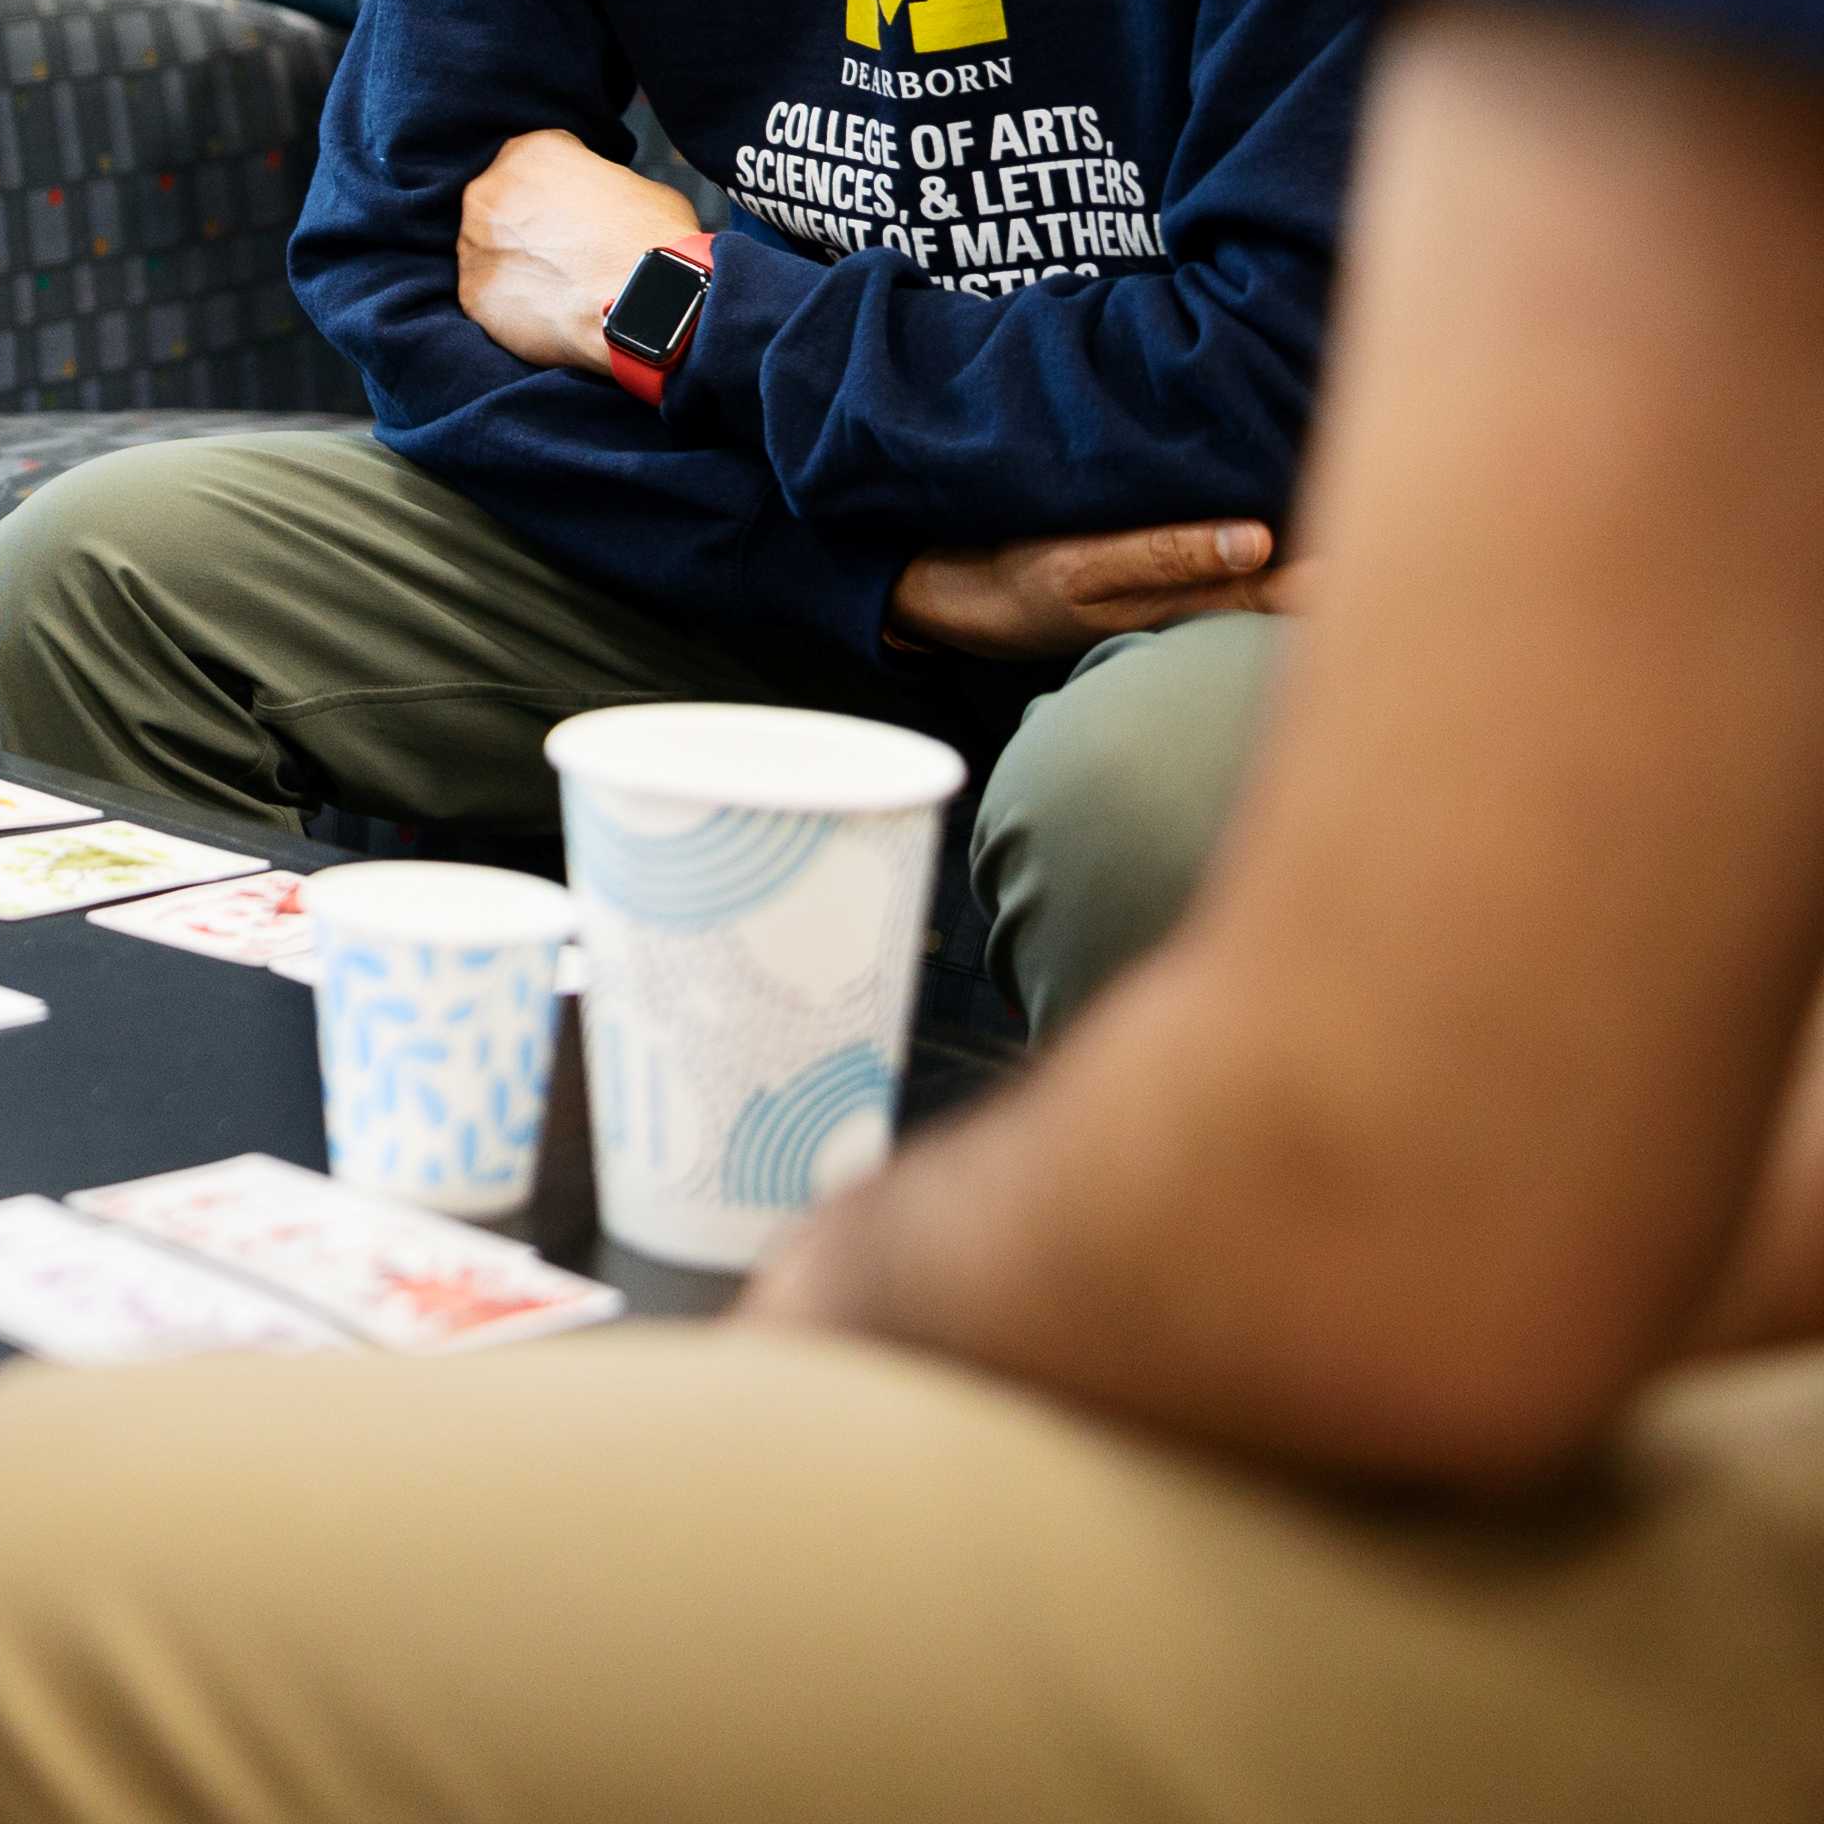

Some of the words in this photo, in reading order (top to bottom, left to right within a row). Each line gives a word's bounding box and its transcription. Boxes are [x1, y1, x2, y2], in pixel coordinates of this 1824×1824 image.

[840, 56, 1014, 100] DEARBORN
[765, 100, 901, 171] COLLEGE
[911, 119, 975, 170] OF
[989, 105, 1115, 160] ARTS,
[735, 145, 910, 225] SCIENCES,
[919, 175, 963, 220] &
[972, 158, 1145, 217] LETTERS
[882, 224, 938, 269] OF
